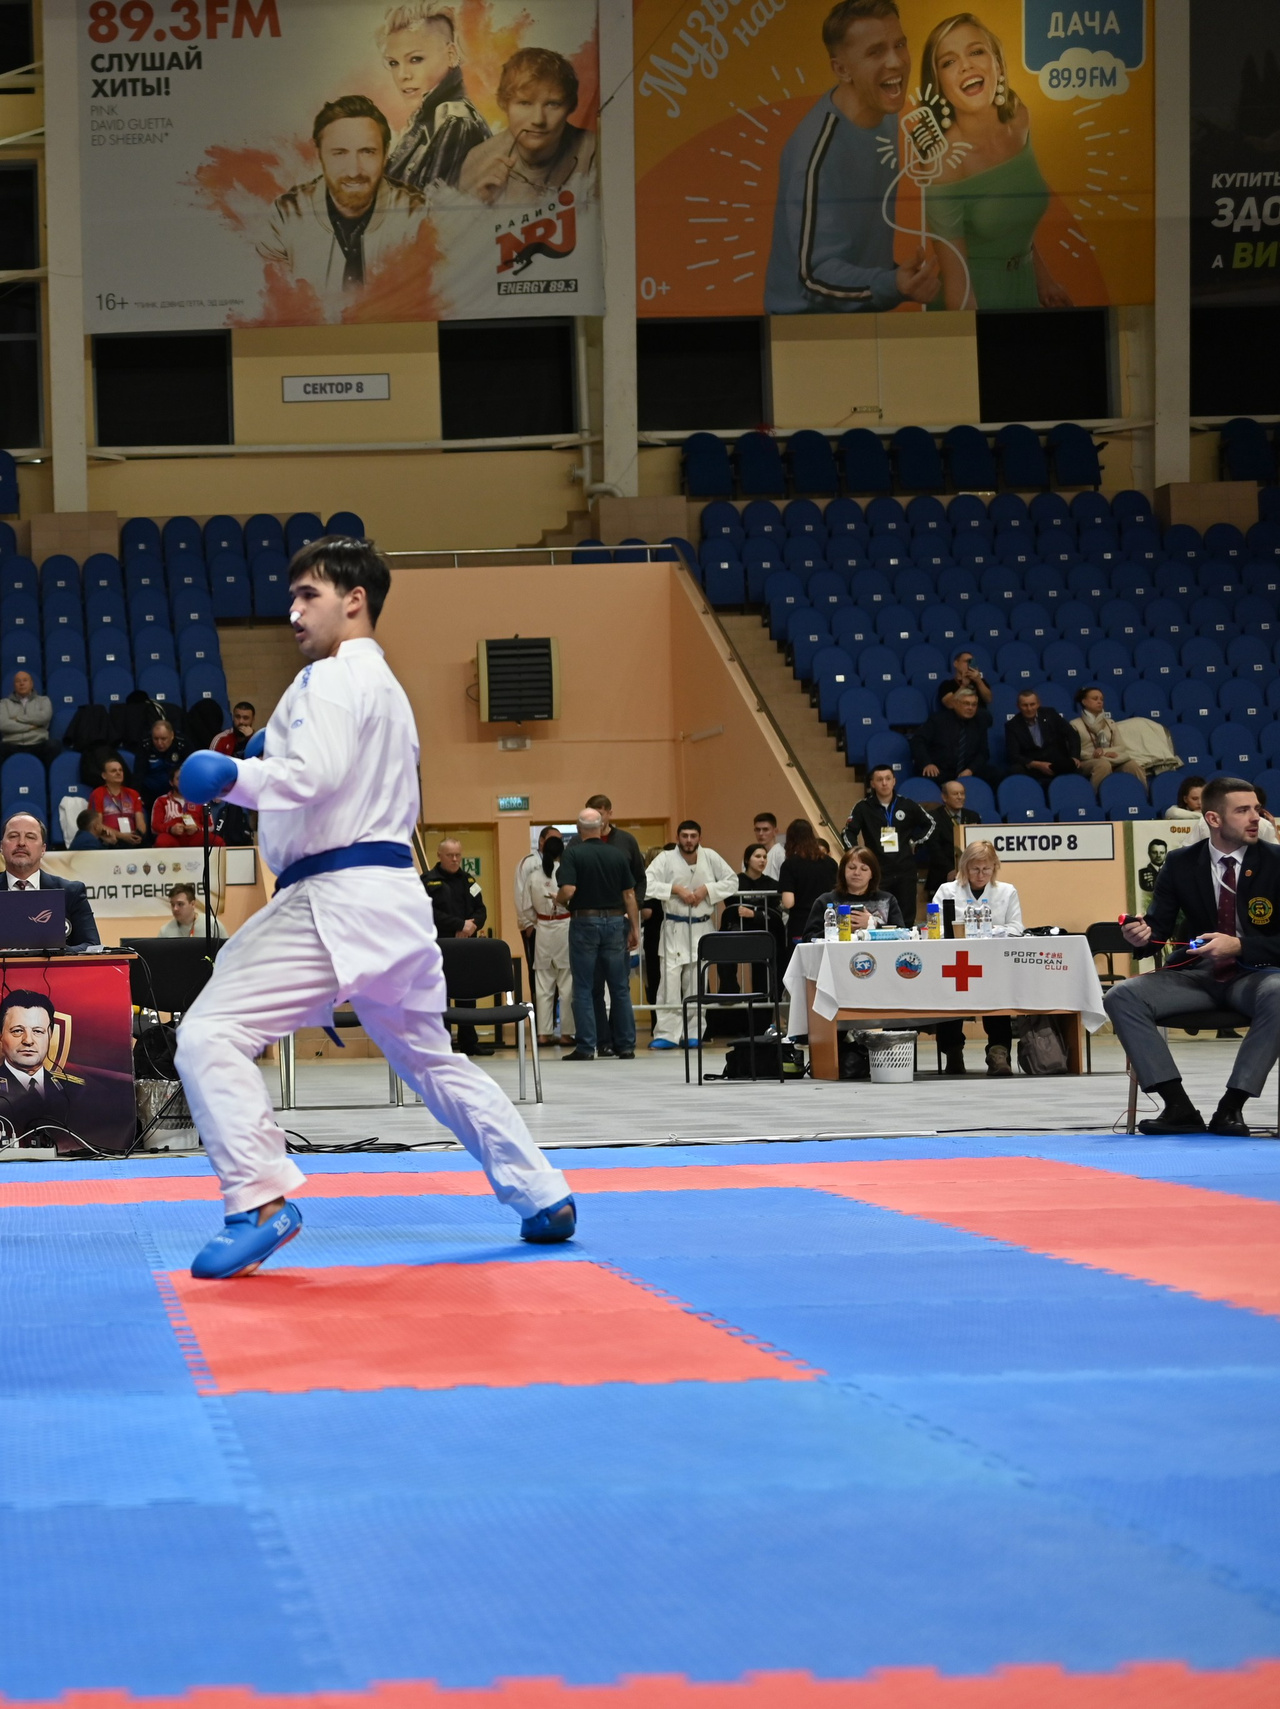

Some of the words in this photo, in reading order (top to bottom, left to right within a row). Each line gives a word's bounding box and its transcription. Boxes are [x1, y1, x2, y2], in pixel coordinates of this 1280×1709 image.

[1047, 10, 1121, 38] ДАЧА
[90, 45, 203, 73] СЛУШАЙ
[91, 77, 171, 98] ХИТЫ!
[90, 105, 119, 116] PINK
[90, 119, 125, 131] DAVID
[127, 117, 174, 130] GUETTA
[91, 135, 106, 146] ED
[495, 203, 556, 232] РАДИО
[1210, 254, 1224, 269] А
[499, 281, 547, 294] ENERGY
[549, 280, 576, 292] 89.3
[640, 279, 671, 299] 0+
[96, 293, 129, 311] 16+
[303, 382, 351, 396] СЕКТОР
[355, 382, 364, 394] 8
[993, 836, 1063, 852] СЕКТОР
[1066, 834, 1079, 850] 8
[86, 884, 118, 900] ДЛЯ
[122, 882, 205, 898] ТРЕНЕВ
[1014, 957, 1063, 965] BUDOKAN
